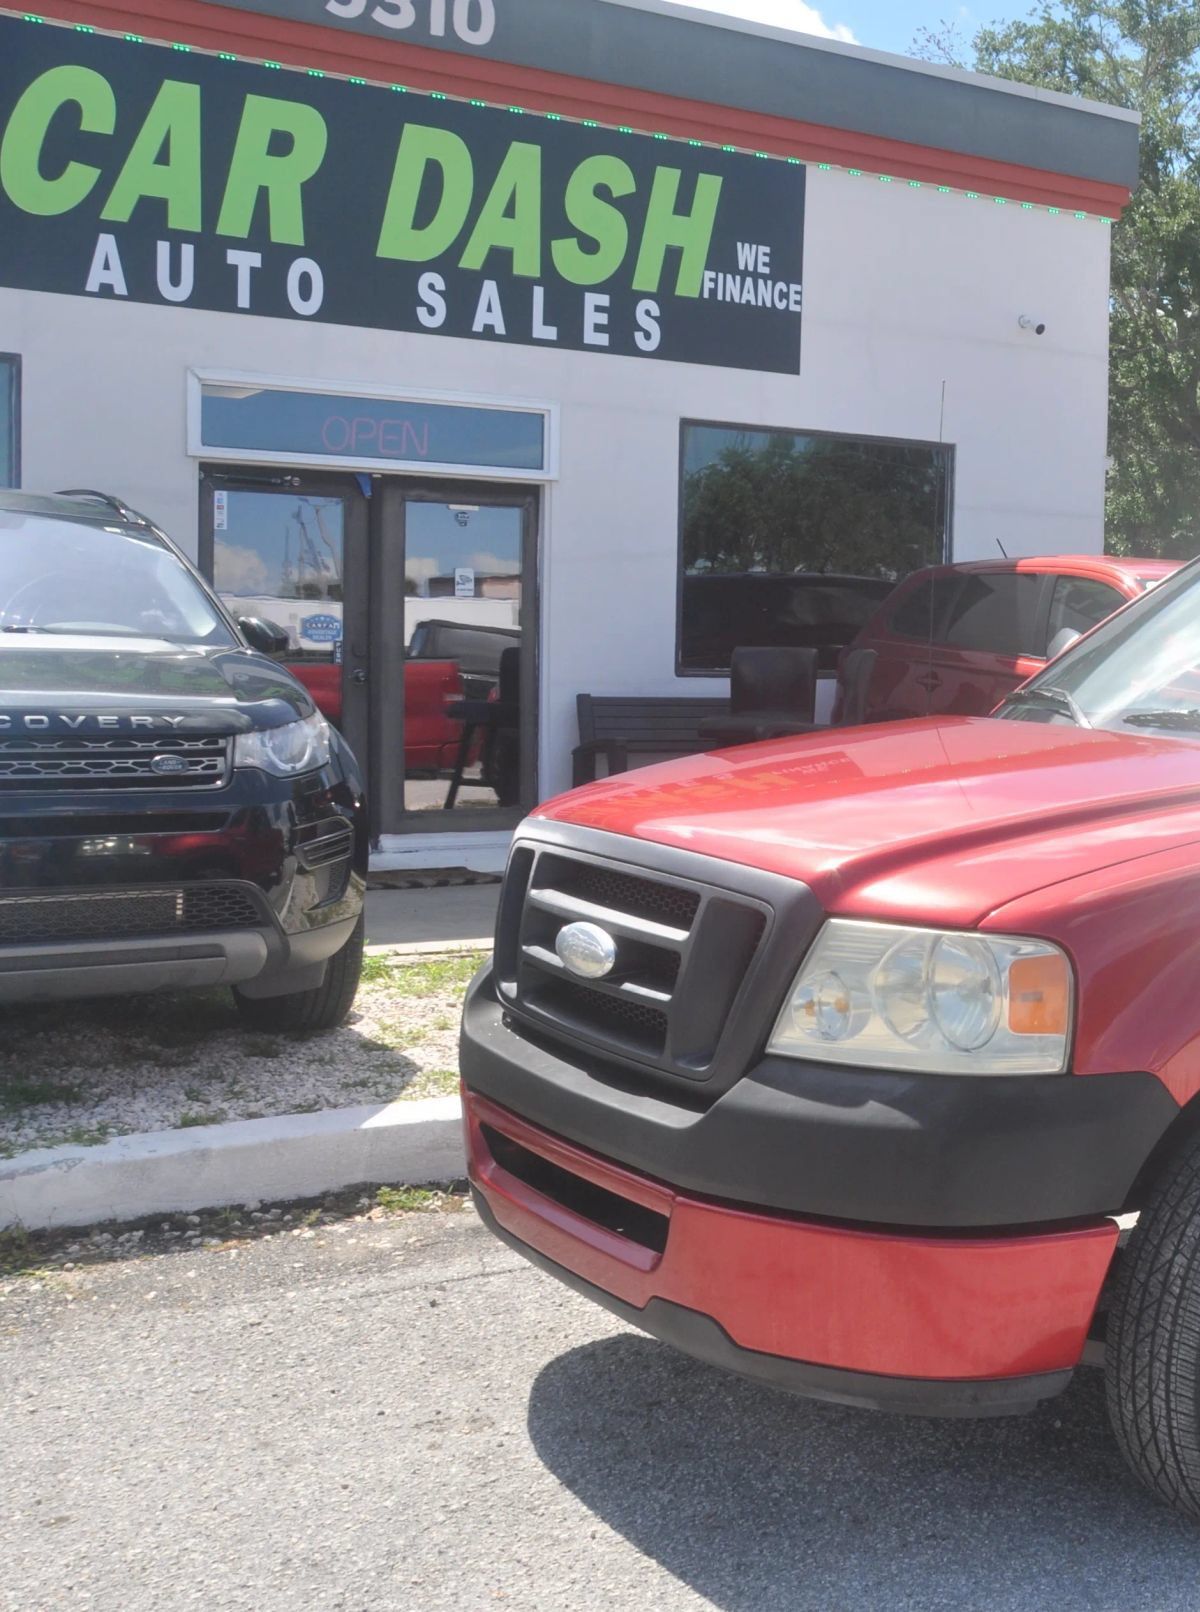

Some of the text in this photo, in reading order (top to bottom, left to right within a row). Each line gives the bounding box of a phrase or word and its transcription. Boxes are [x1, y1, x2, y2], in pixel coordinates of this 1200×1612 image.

[0, 66, 723, 298] CAR DASH
[736, 241, 771, 274] WE
[85, 233, 661, 352] AUTO SALES
[703, 269, 802, 313] FINANCE
[321, 415, 430, 456] OPEN
